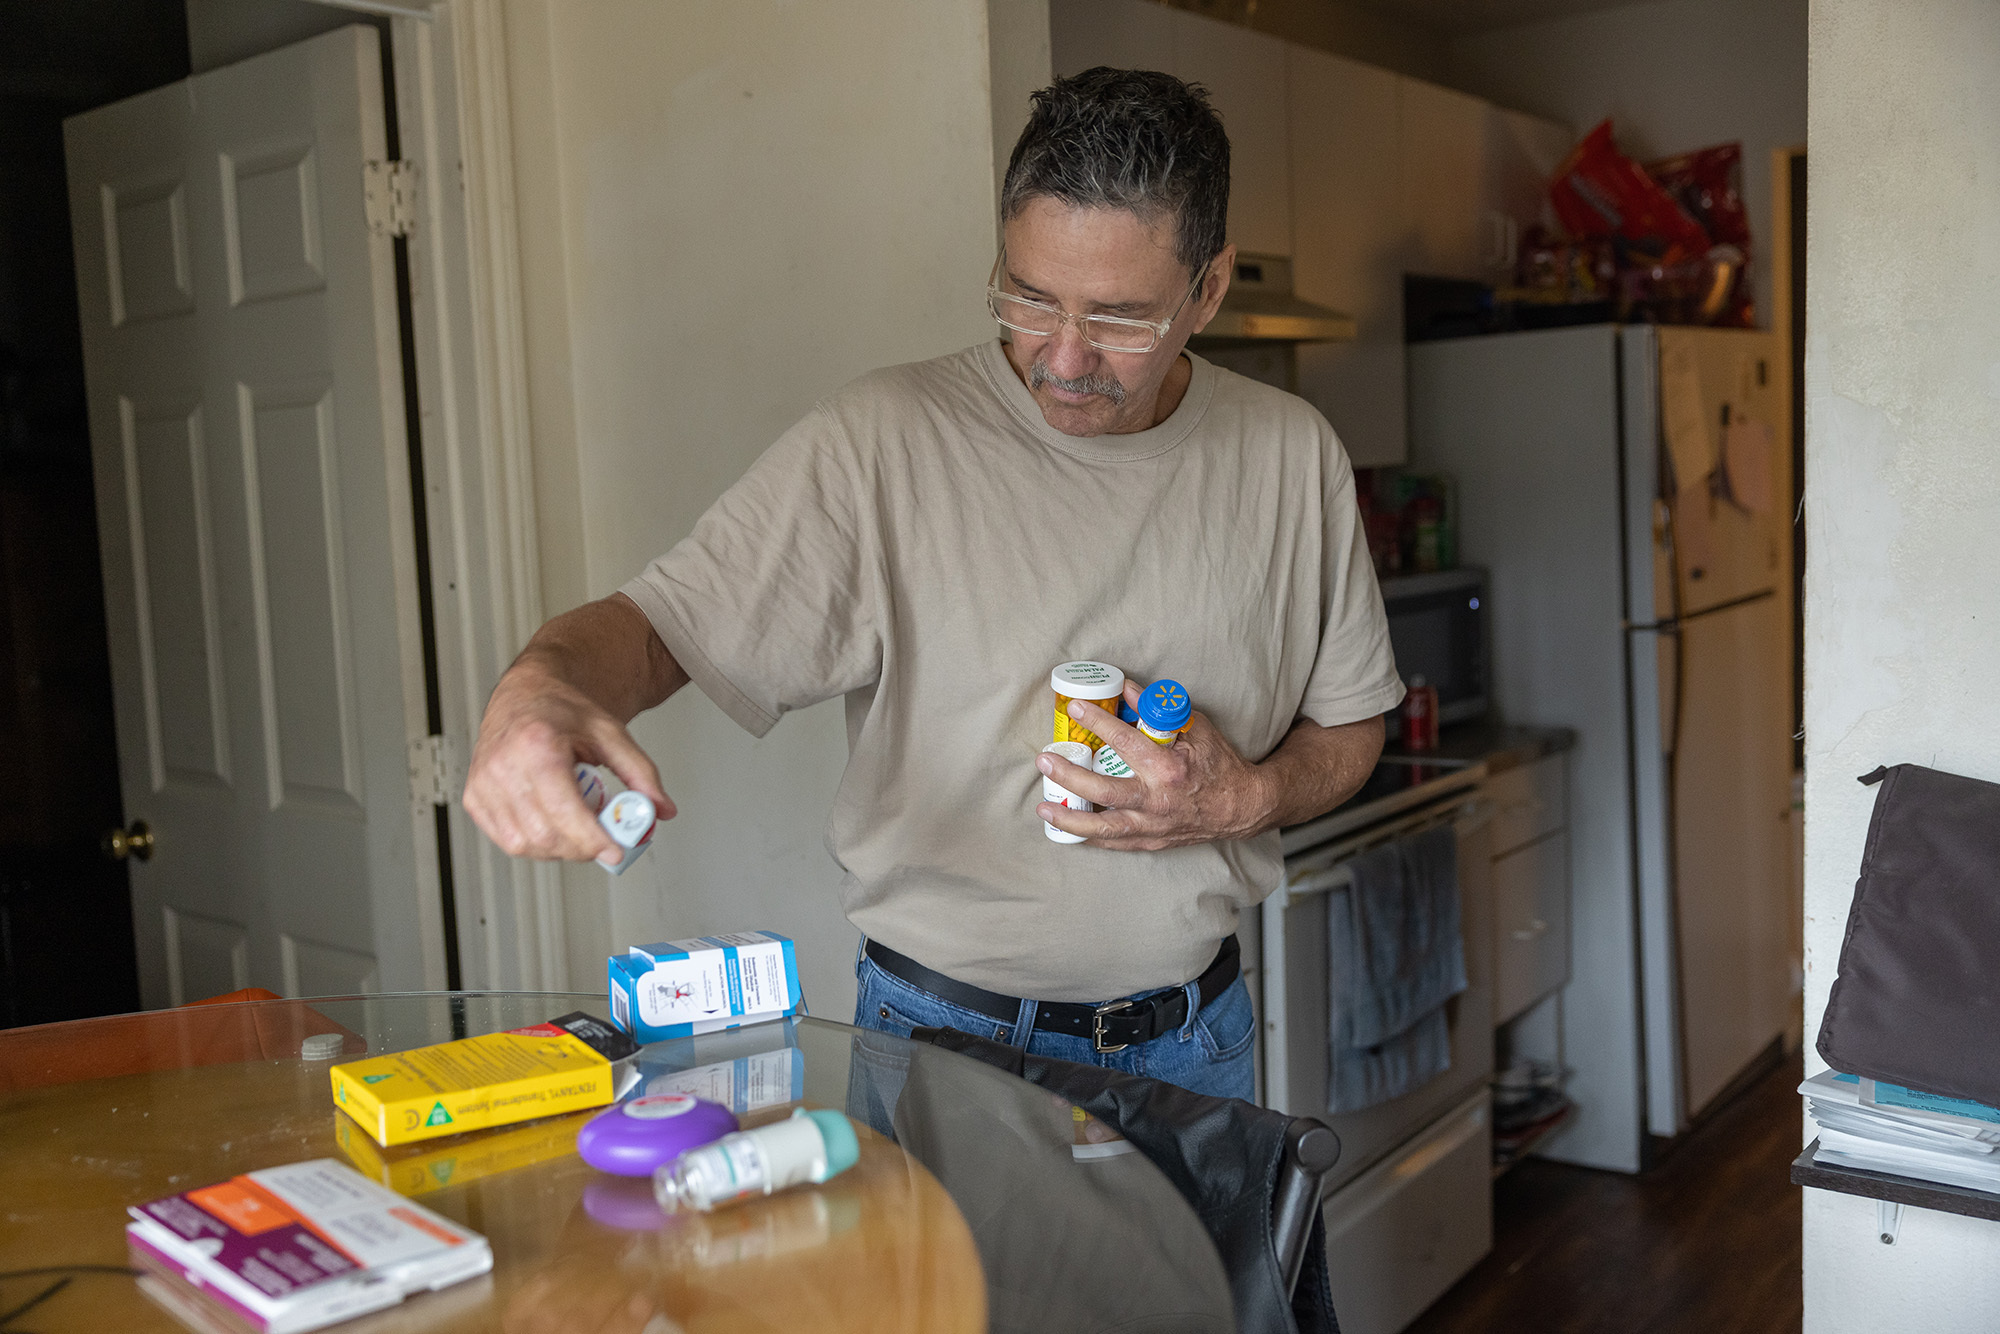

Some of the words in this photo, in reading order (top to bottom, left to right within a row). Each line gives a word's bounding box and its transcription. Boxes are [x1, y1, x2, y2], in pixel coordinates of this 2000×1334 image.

[1099, 755, 1114, 765] PUSH
[1104, 763, 1121, 774] PALM
[549, 1081, 597, 1100] FENTANYL
[457, 1100, 491, 1115] System
[493, 1093, 547, 1108] Transdermal
